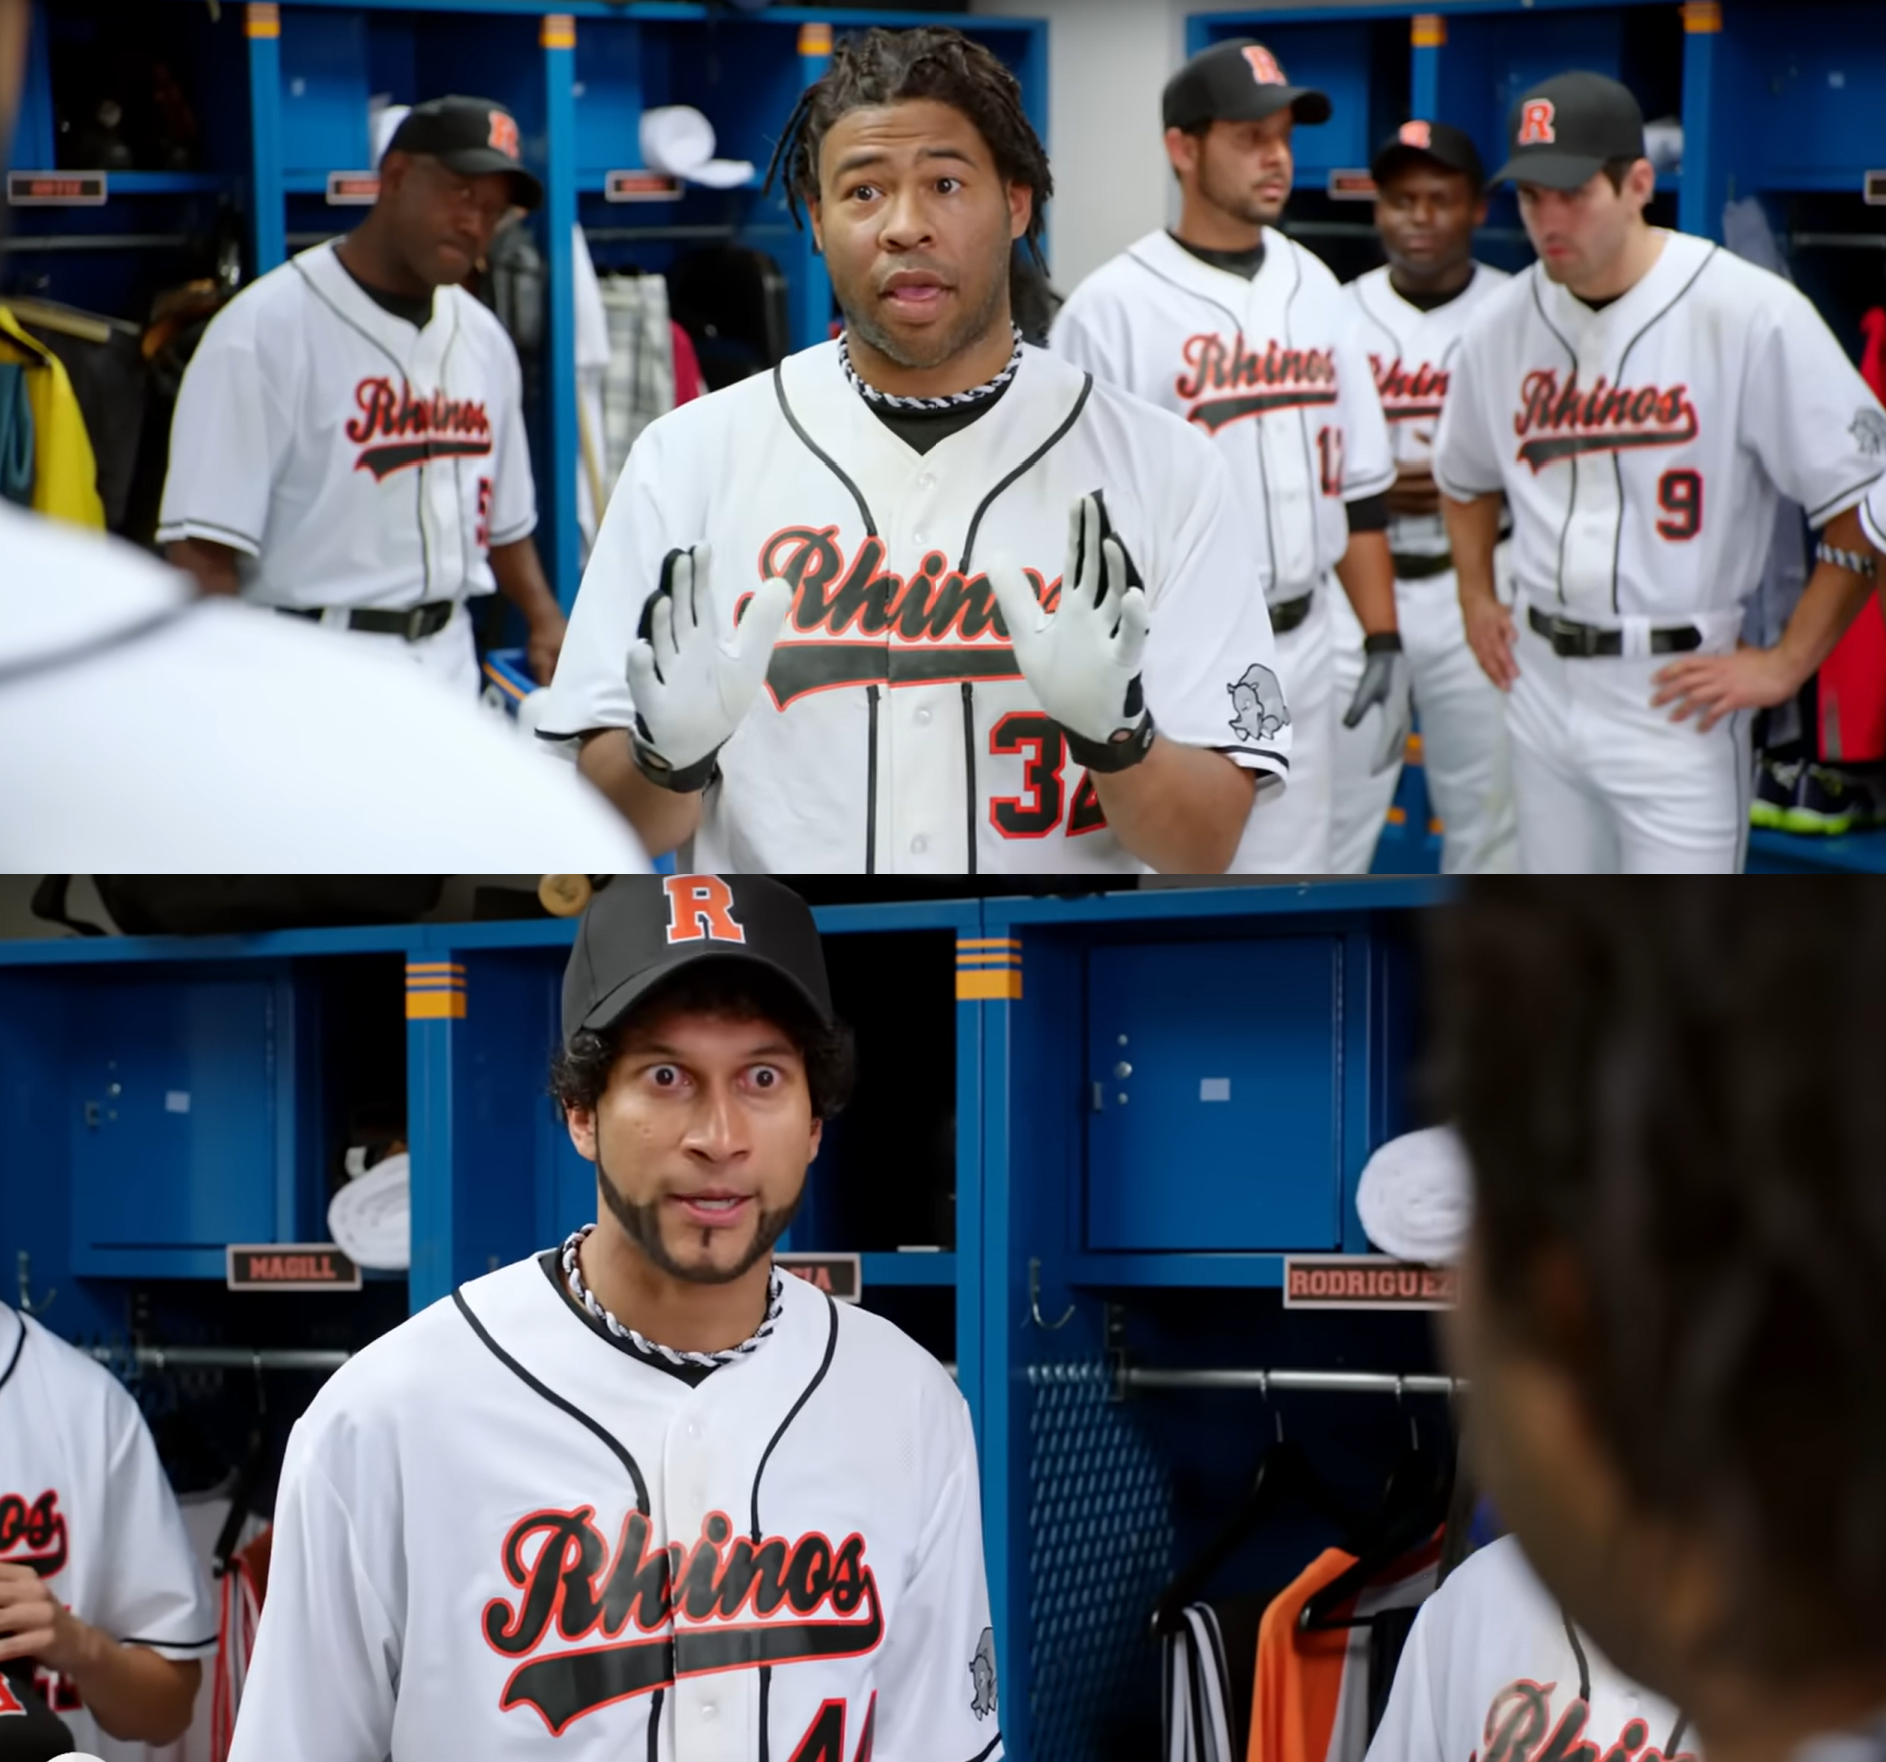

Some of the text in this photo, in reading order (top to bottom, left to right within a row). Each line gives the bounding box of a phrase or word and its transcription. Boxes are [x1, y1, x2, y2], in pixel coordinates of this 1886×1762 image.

[1518, 98, 1555, 146] R
[1176, 332, 1336, 400] Rhinos
[345, 375, 491, 444] Rhinos
[1514, 368, 1688, 437] Rhinos
[1655, 468, 1703, 541] 9
[734, 525, 1064, 643] Rhin
[663, 874, 746, 945] R
[249, 1255, 337, 1279] MAGILL
[481, 1505, 870, 1658] Rhinos
